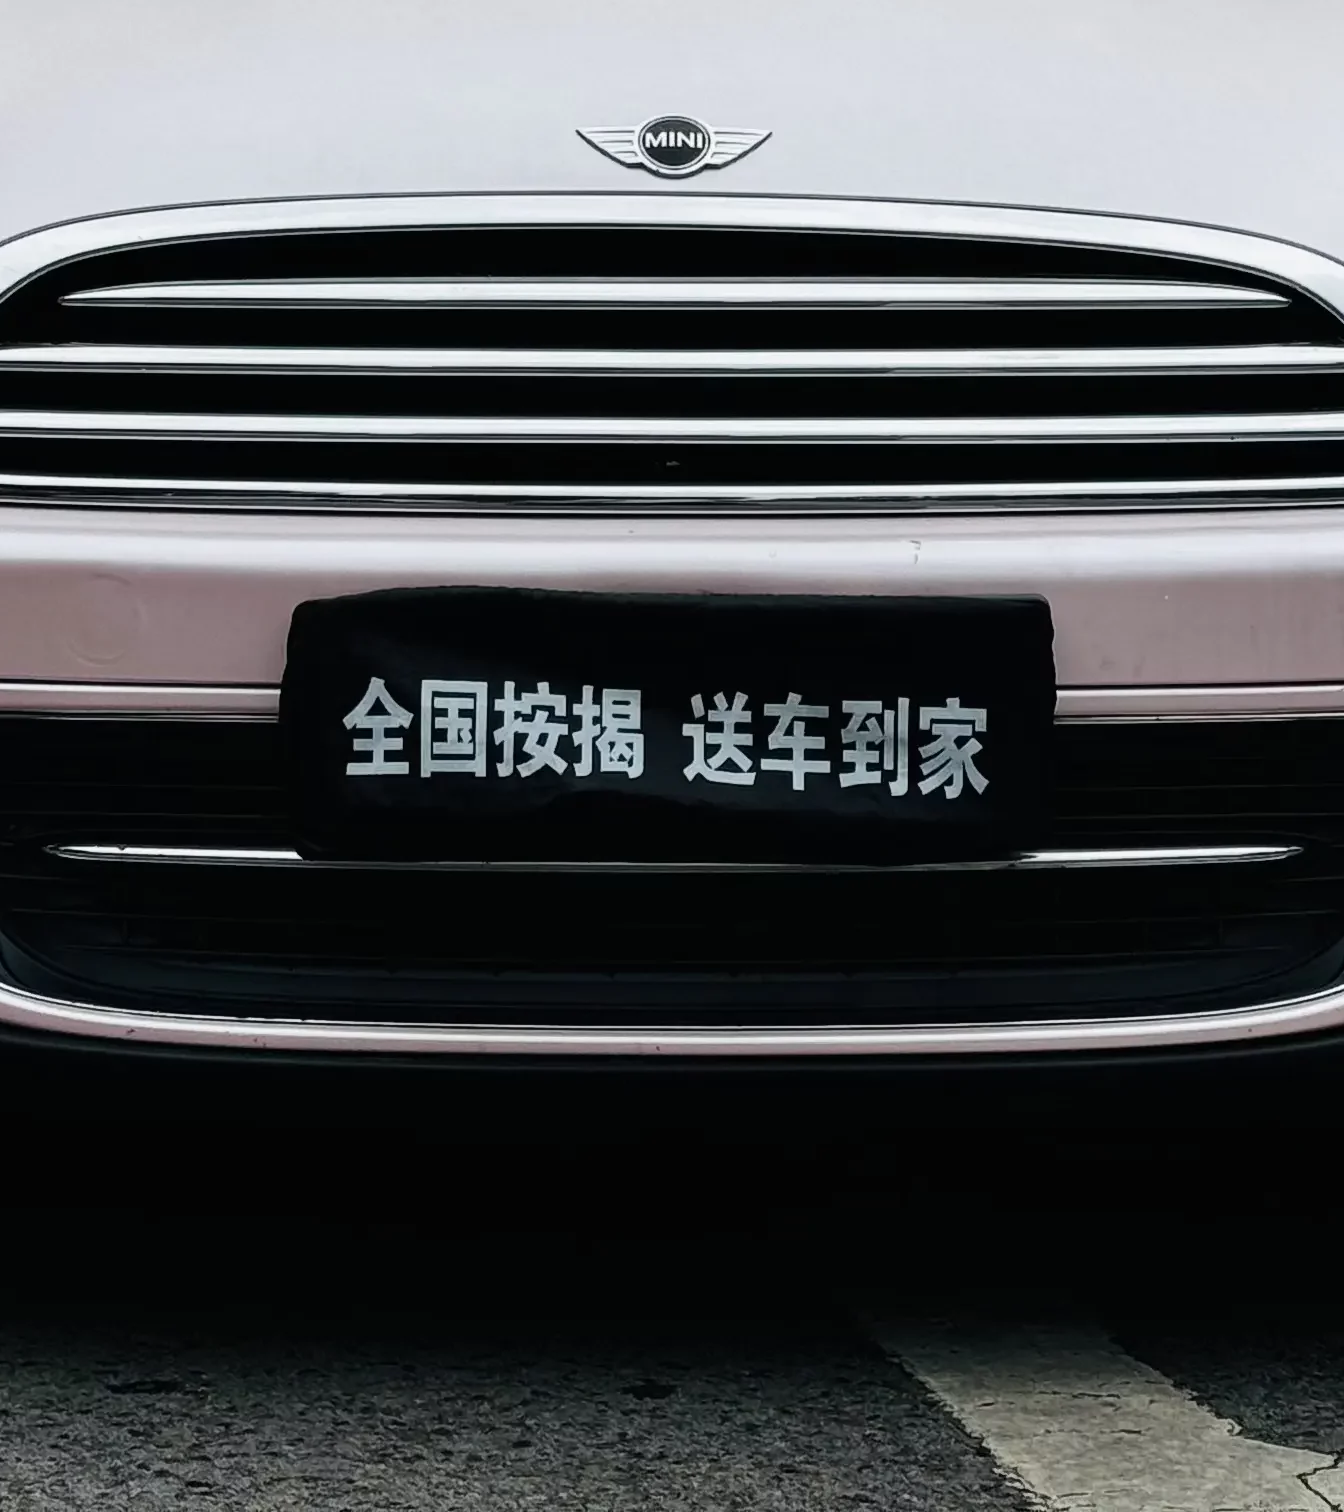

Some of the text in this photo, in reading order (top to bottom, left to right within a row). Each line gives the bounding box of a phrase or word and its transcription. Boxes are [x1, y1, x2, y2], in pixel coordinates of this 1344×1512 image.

[644, 131, 704, 149] MINI
[342, 676, 991, 800] 全国按揭 送车到家
